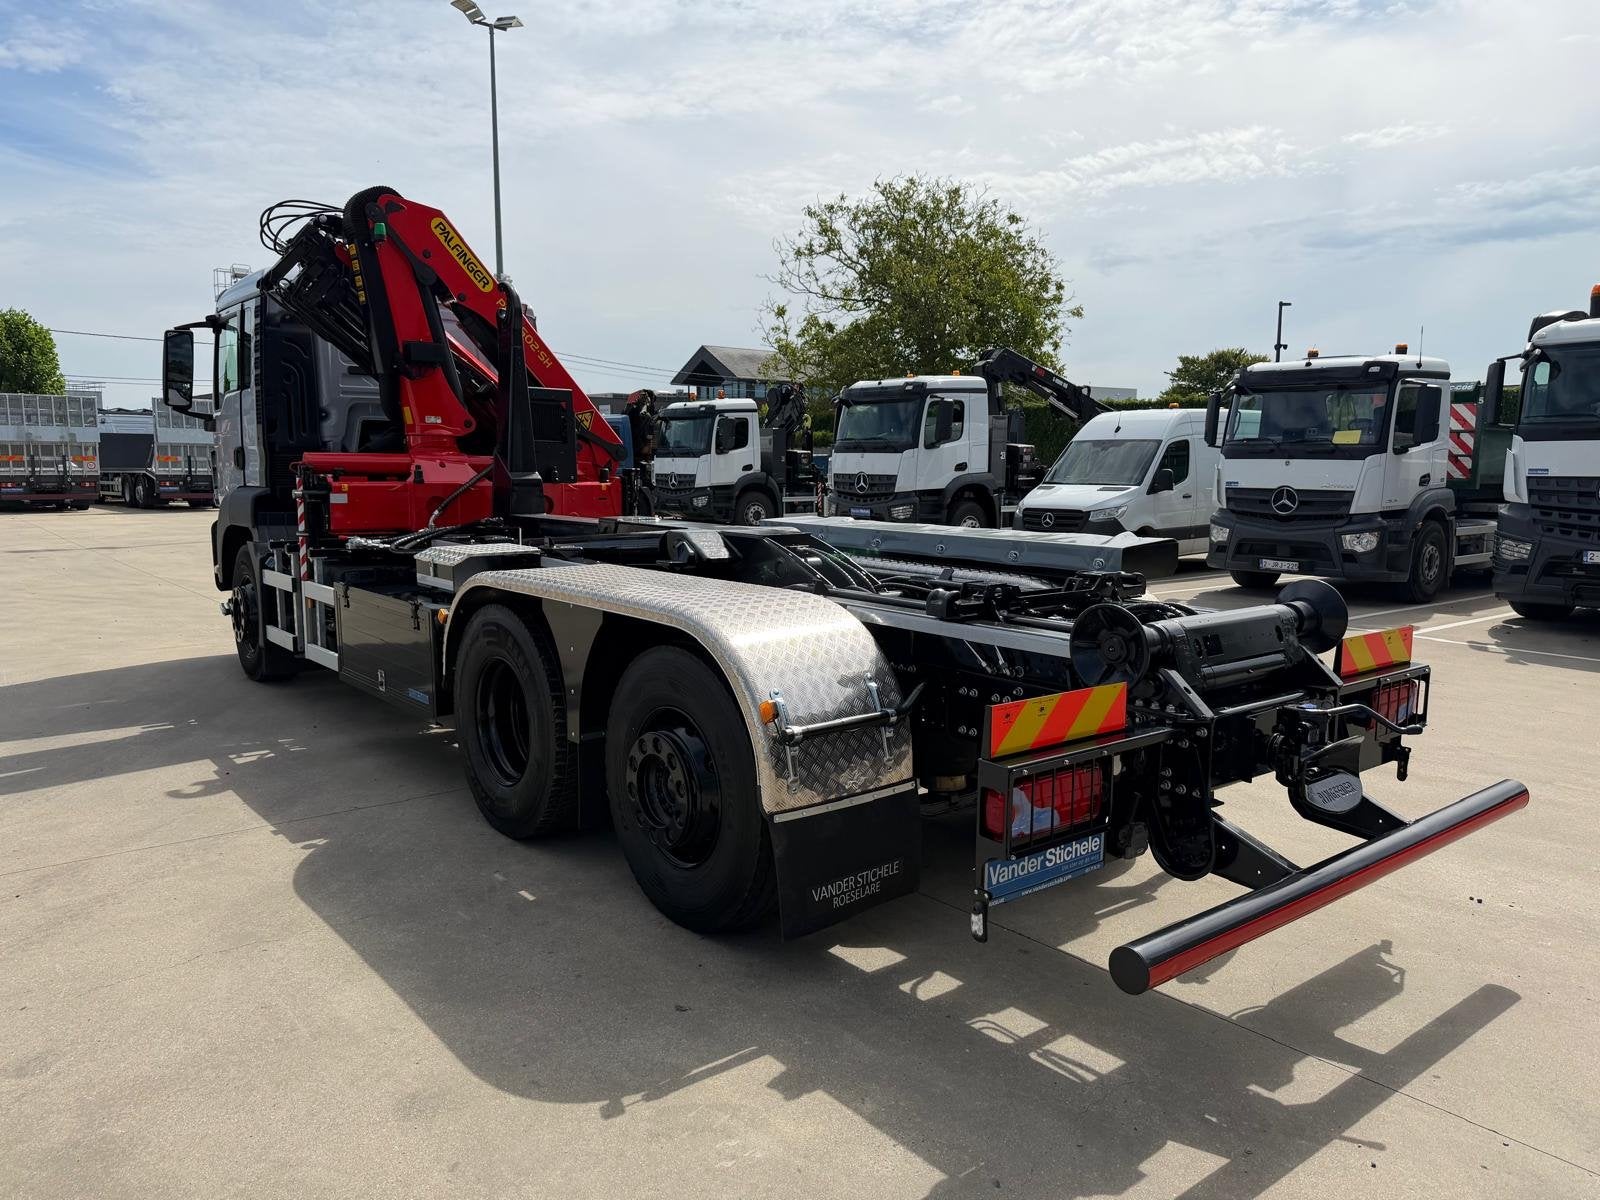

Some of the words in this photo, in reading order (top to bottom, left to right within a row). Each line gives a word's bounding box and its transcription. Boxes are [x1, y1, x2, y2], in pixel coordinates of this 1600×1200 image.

[434, 221, 490, 289] PALFINGER
[812, 876, 855, 902] VANDER
[857, 860, 899, 887] STICHELE
[989, 855, 1044, 885] Vander
[1045, 836, 1100, 867] Stichele
[833, 880, 881, 909] ROESELARE
